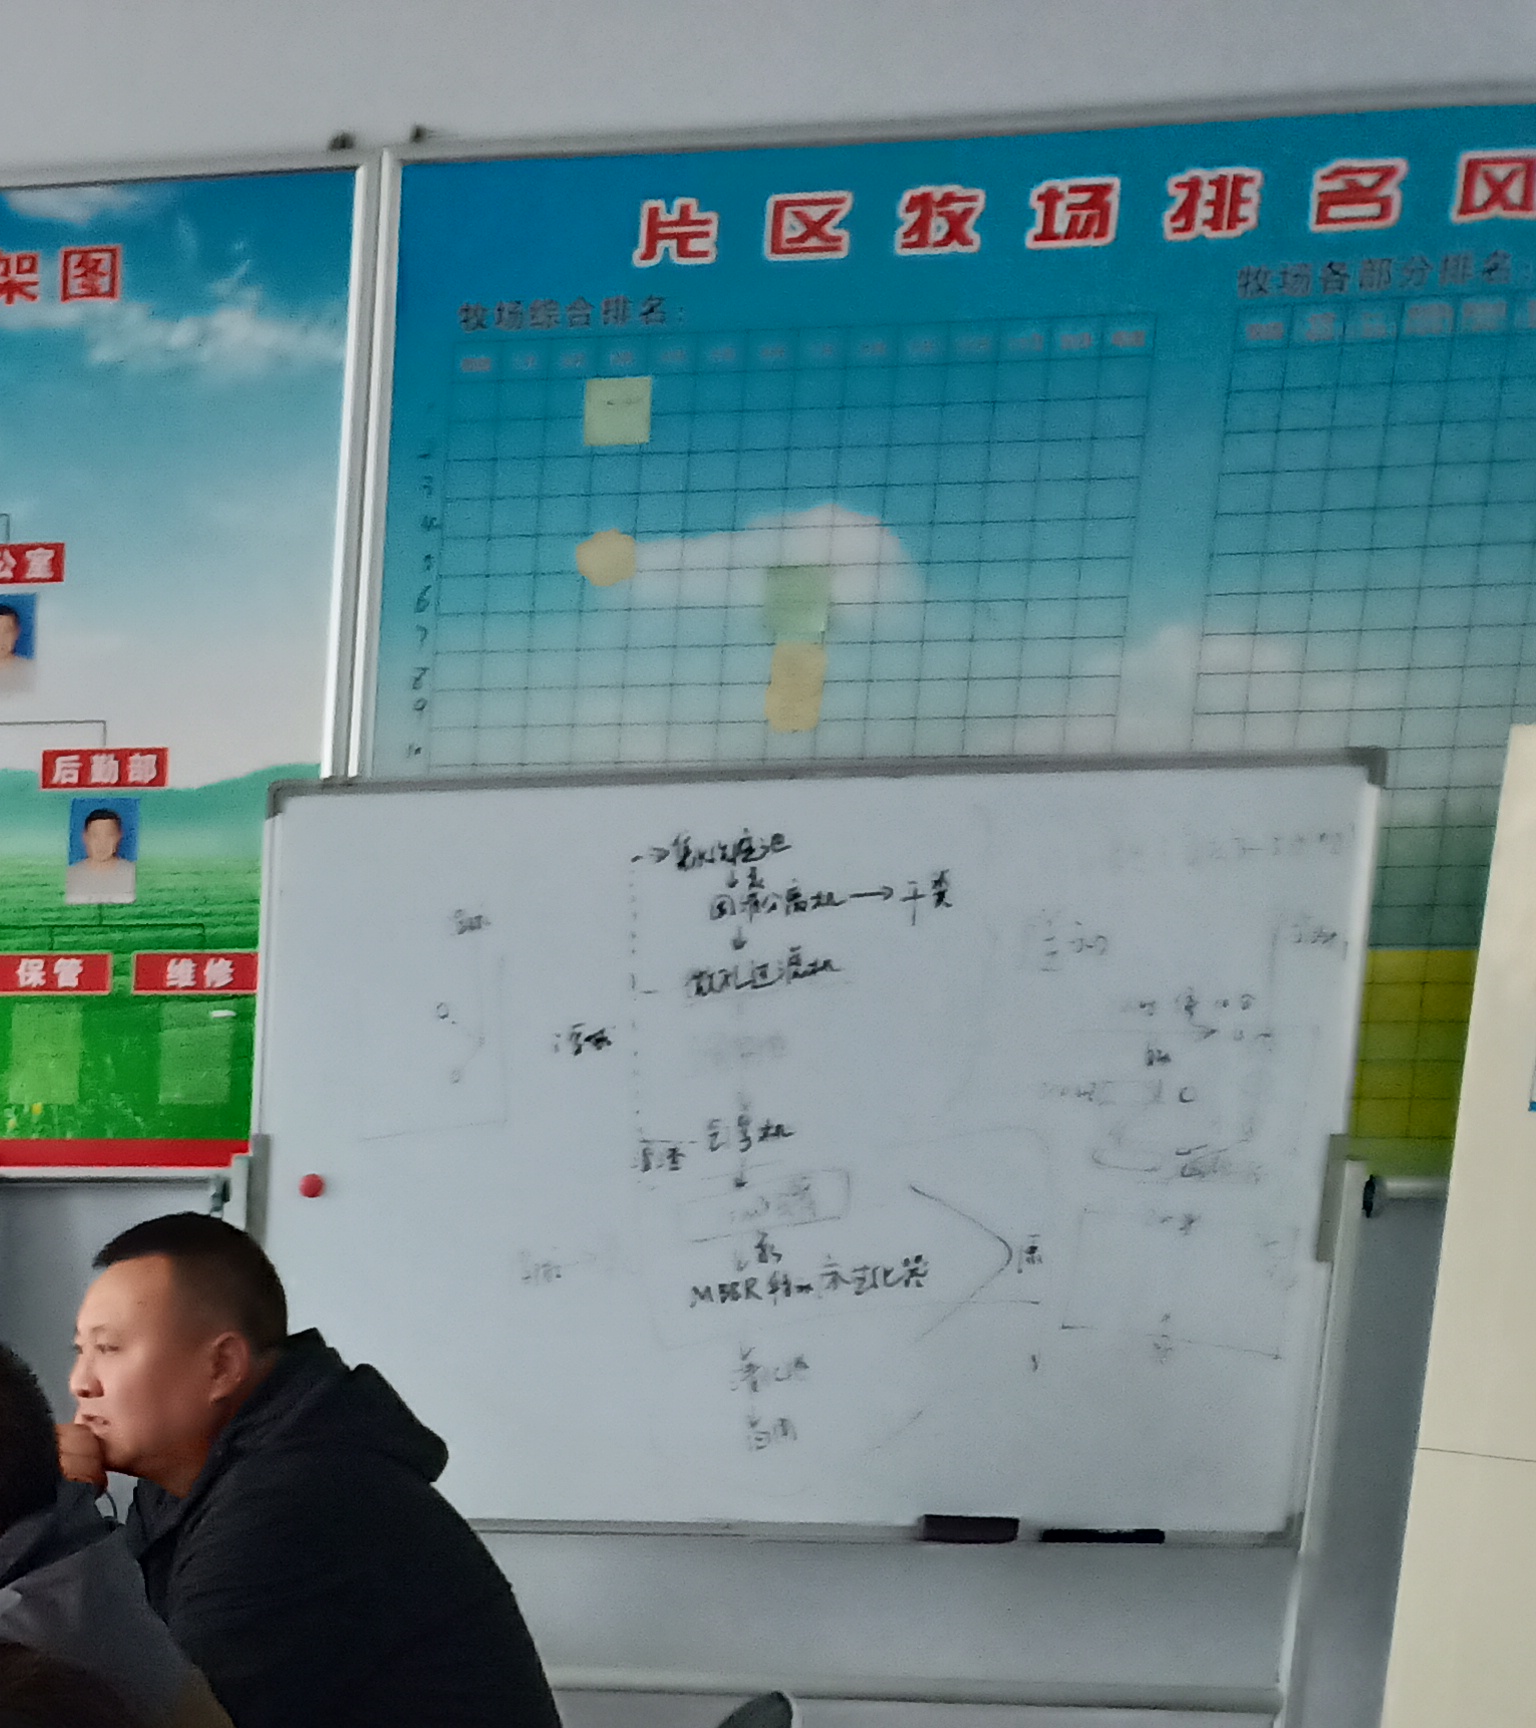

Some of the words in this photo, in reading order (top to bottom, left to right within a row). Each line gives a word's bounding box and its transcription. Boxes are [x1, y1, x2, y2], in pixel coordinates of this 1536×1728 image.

[51, 752, 158, 786] 后勤部
[16, 957, 84, 988] 保管
[165, 957, 236, 988] 维修
